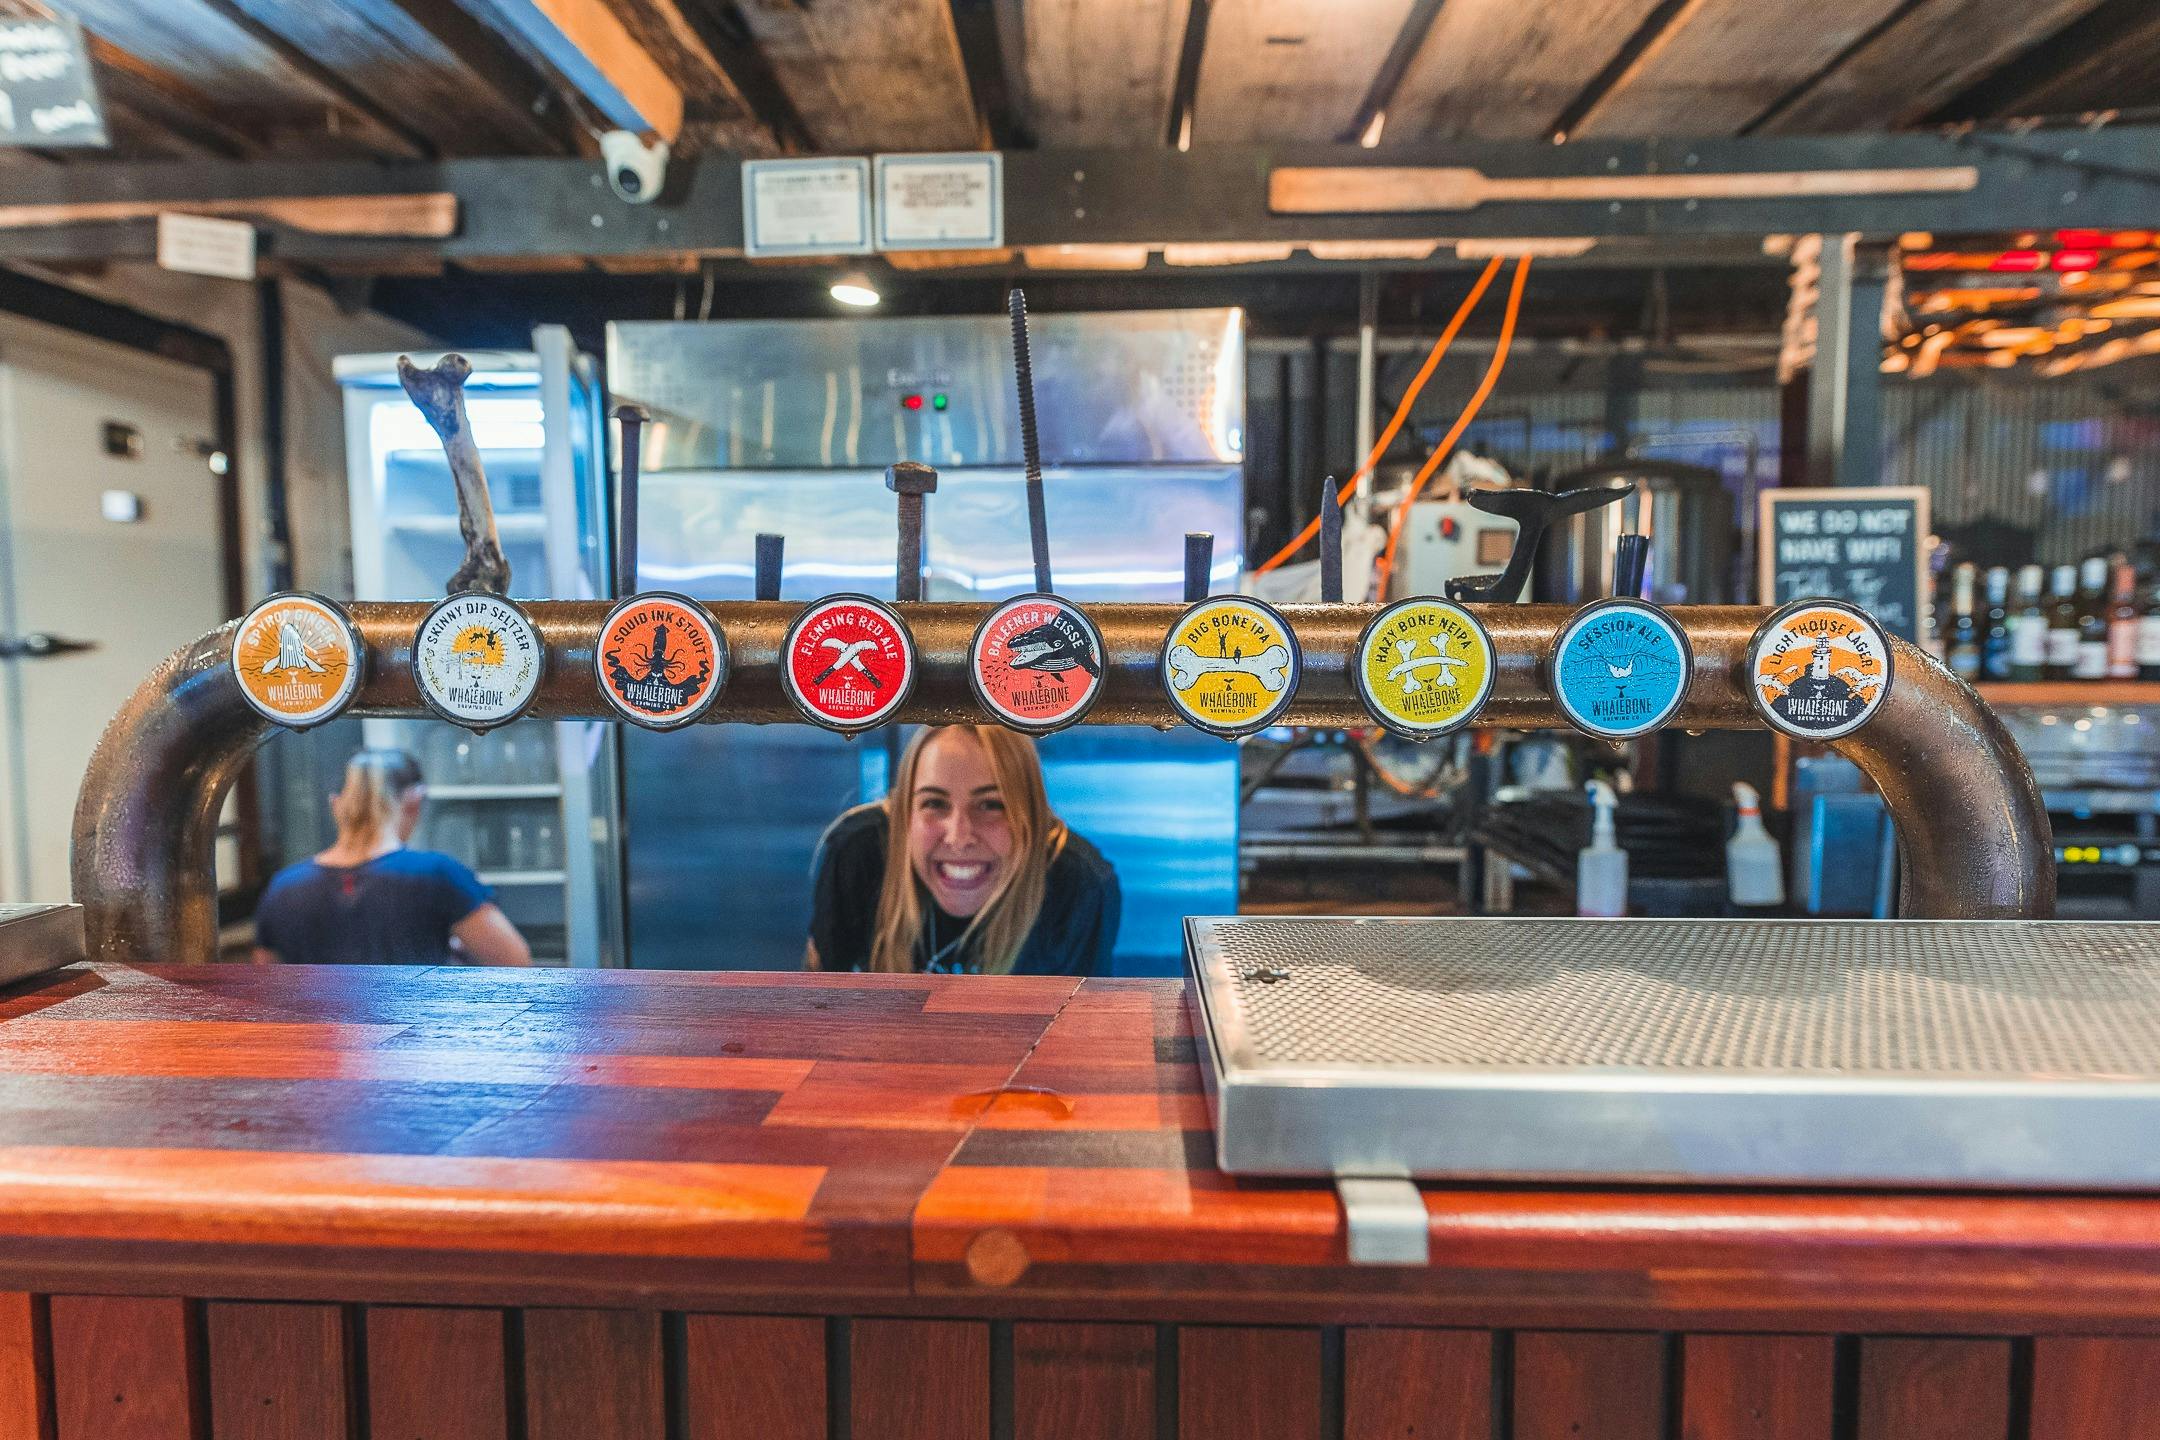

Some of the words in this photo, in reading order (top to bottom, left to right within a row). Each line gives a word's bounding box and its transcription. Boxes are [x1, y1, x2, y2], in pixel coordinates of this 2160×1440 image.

[1779, 509, 1818, 534] WE
[1820, 509, 1858, 534] DO
[1859, 508, 1911, 534] NOT
[1779, 537, 1839, 564] HAVE
[247, 609, 290, 647] SPYHOP
[295, 609, 337, 644] GINGER
[428, 606, 462, 644] SKINNY
[466, 603, 487, 614] DIP
[491, 606, 530, 650] SELTZER
[614, 612, 647, 644] SQUID
[651, 610, 674, 623] INK
[676, 617, 706, 654] STOUT
[801, 613, 854, 656] FLENSING
[858, 615, 883, 636] RED
[880, 637, 898, 660] ALE
[988, 612, 1039, 656] BALEENER
[1043, 612, 1084, 649] WEISSE
[1188, 622, 1209, 643] BIG
[1212, 615, 1249, 628] BONE
[1250, 623, 1270, 643] IPA
[1376, 628, 1398, 662] HAZY
[1398, 615, 1435, 632] BONE
[1440, 617, 1472, 650] NEIPA
[1579, 620, 1635, 650] SESSION
[1638, 626, 1662, 646] ALE
[1770, 619, 1846, 665] LIGHTHOUSE
[1846, 629, 1873, 668] LAGER
[268, 683, 323, 701] WHALEBONE
[449, 687, 503, 706] WHALEBONE
[627, 683, 683, 705] WHALEBONE
[819, 688, 876, 706] WHALEBONE
[1012, 686, 1070, 706] WHALEBONE
[1200, 692, 1258, 708] WHALEBONE
[1402, 688, 1460, 712] WHALEBONE
[1592, 698, 1652, 716] WHALEBONE
[1788, 698, 1849, 716] WHALEBONE
